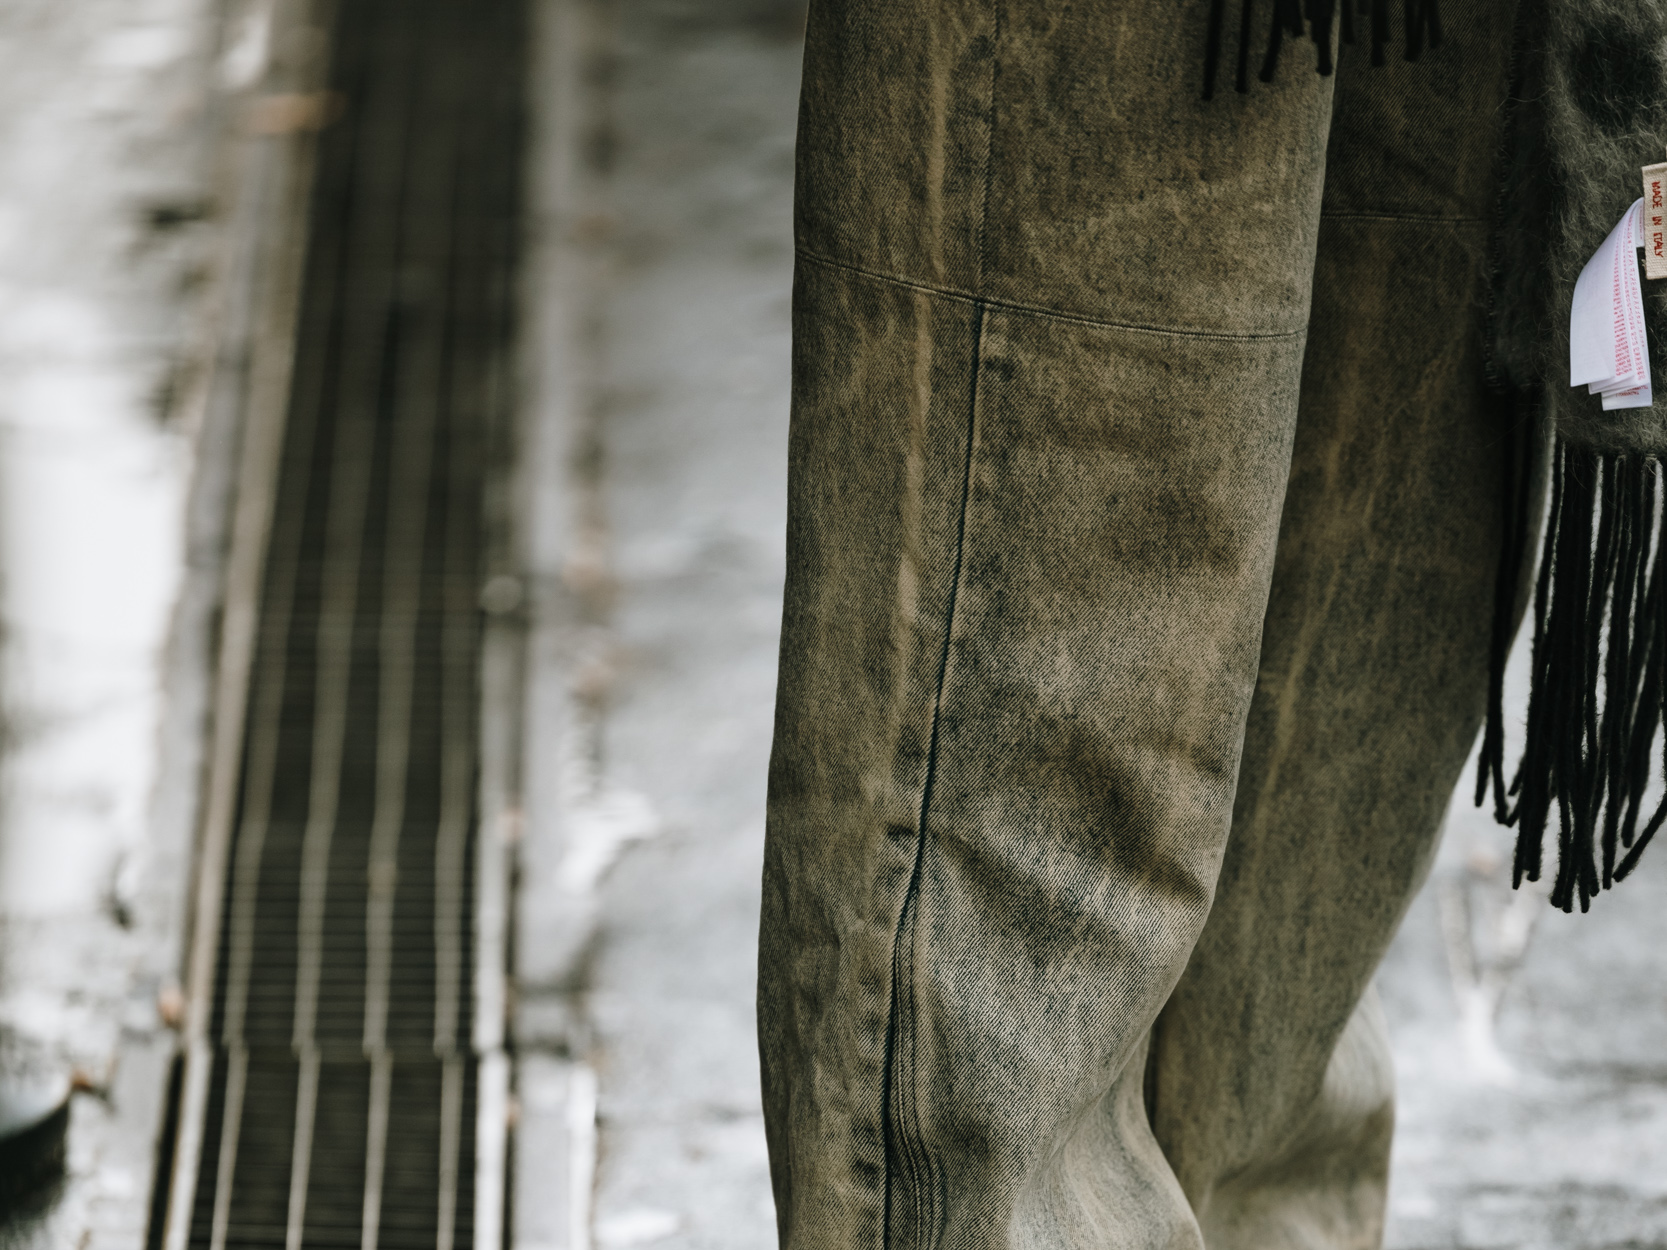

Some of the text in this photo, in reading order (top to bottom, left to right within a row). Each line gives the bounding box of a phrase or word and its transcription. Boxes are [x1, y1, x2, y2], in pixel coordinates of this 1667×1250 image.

[1652, 181, 1664, 258] MADE IN ITALY
